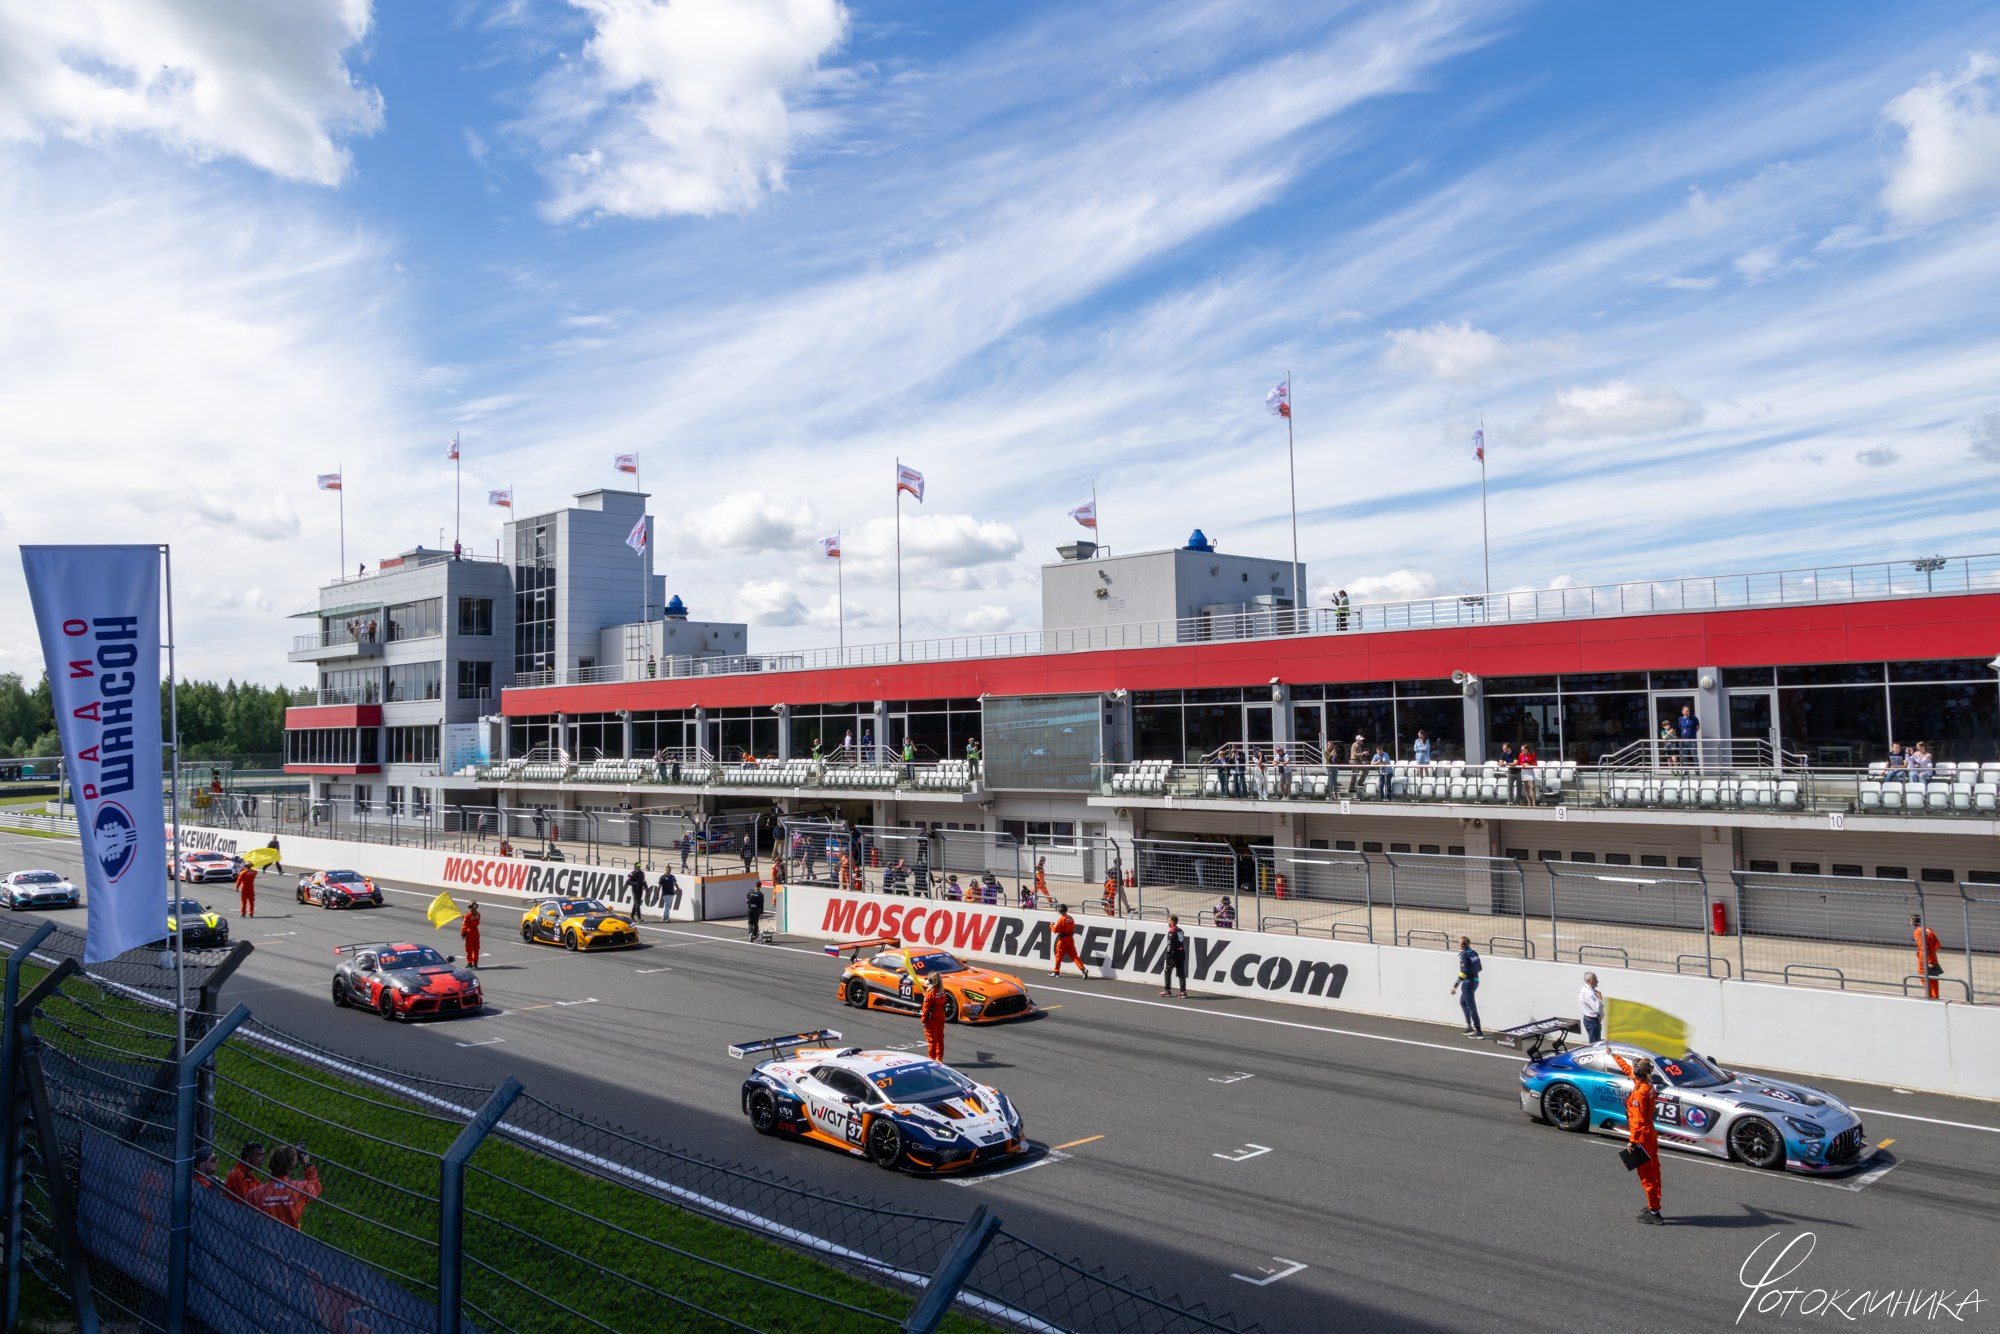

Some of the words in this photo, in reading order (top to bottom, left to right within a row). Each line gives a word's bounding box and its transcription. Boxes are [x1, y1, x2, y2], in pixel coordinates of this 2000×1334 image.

[62, 618, 101, 801] РАДИО
[93, 615, 138, 796] ШАНСОН
[1343, 802, 1348, 813] 8
[1558, 808, 1564, 820] 9
[1830, 815, 1843, 828] 10
[443, 857, 683, 911] MOSCOWRACEWAY.om
[822, 898, 1349, 999] MOSCOWRAEWY.com
[912, 961, 925, 970] 10
[900, 985, 912, 996] 10
[1664, 1064, 1683, 1076] 13
[876, 1077, 893, 1089] 37
[1600, 1094, 1626, 1106] ФОРТ
[1655, 1102, 1677, 1119] 13
[848, 1122, 863, 1139] 37
